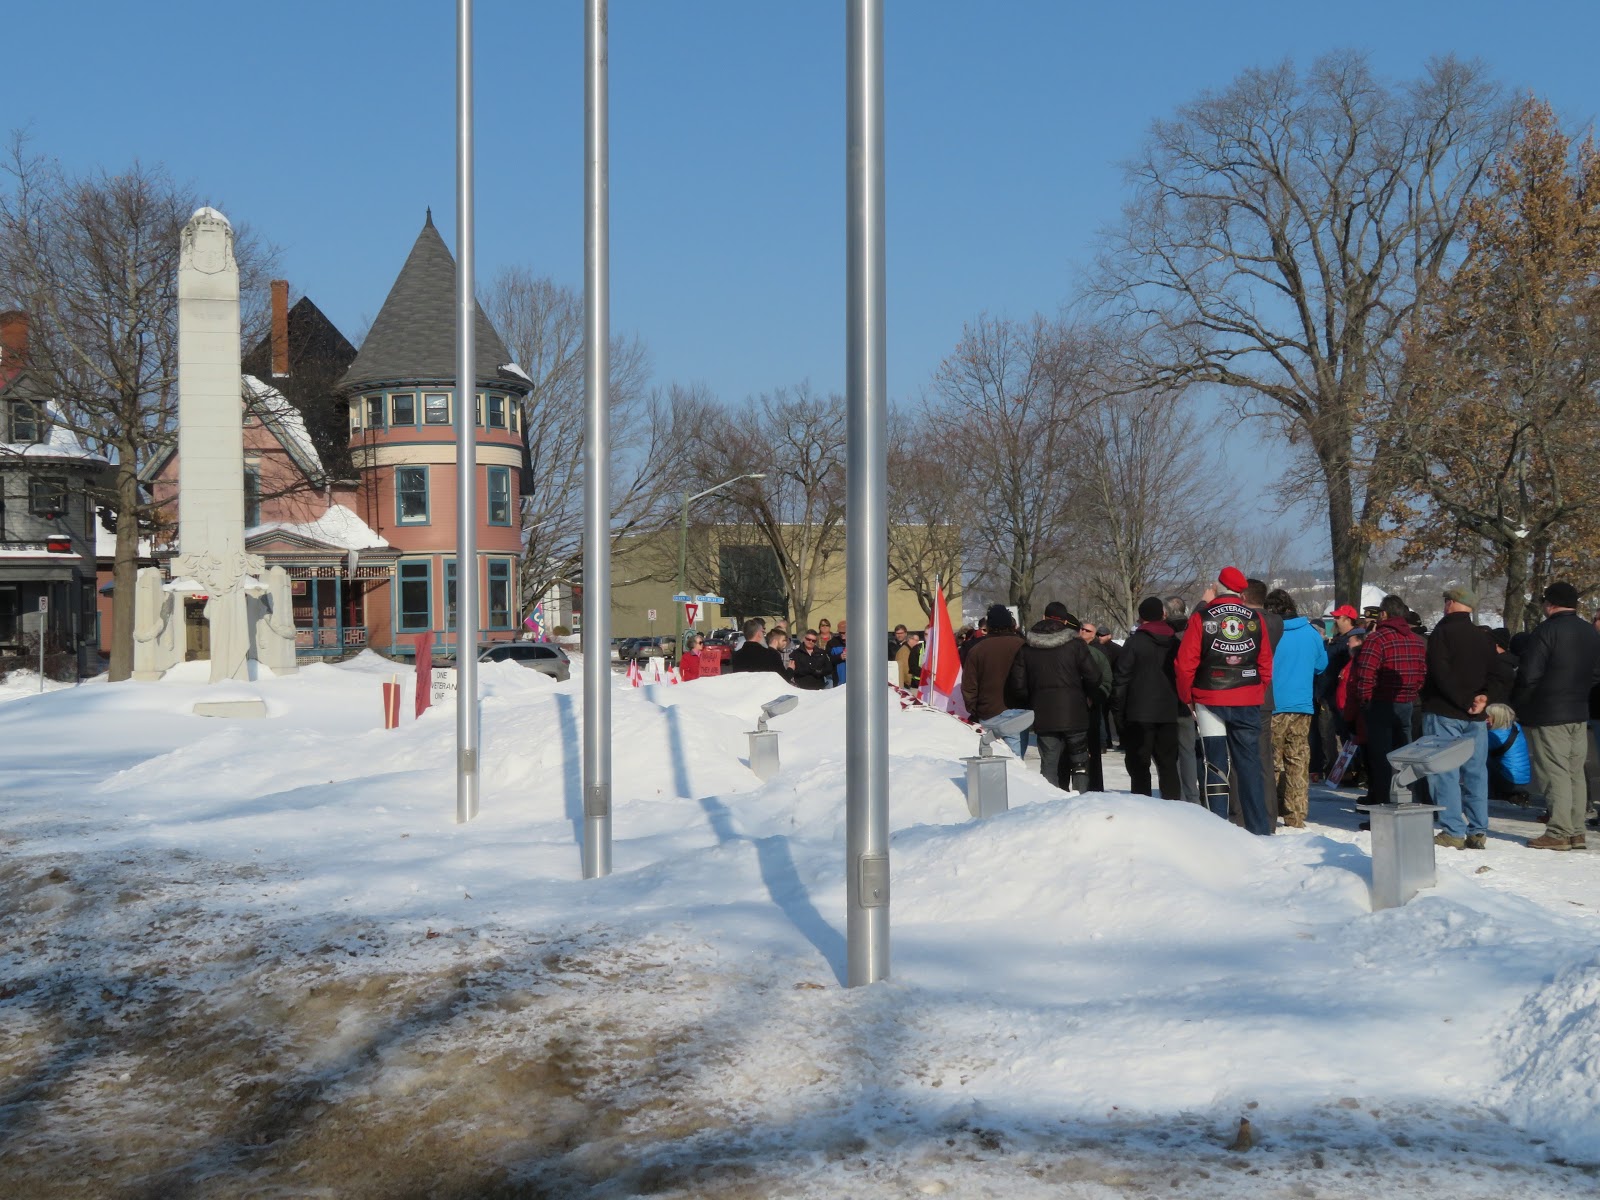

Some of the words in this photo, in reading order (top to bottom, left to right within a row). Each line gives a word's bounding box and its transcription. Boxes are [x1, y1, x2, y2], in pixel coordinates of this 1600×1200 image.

[1215, 605, 1247, 615] VETERAN
[1220, 643, 1249, 651] CANADA
[437, 671, 447, 679] ONE
